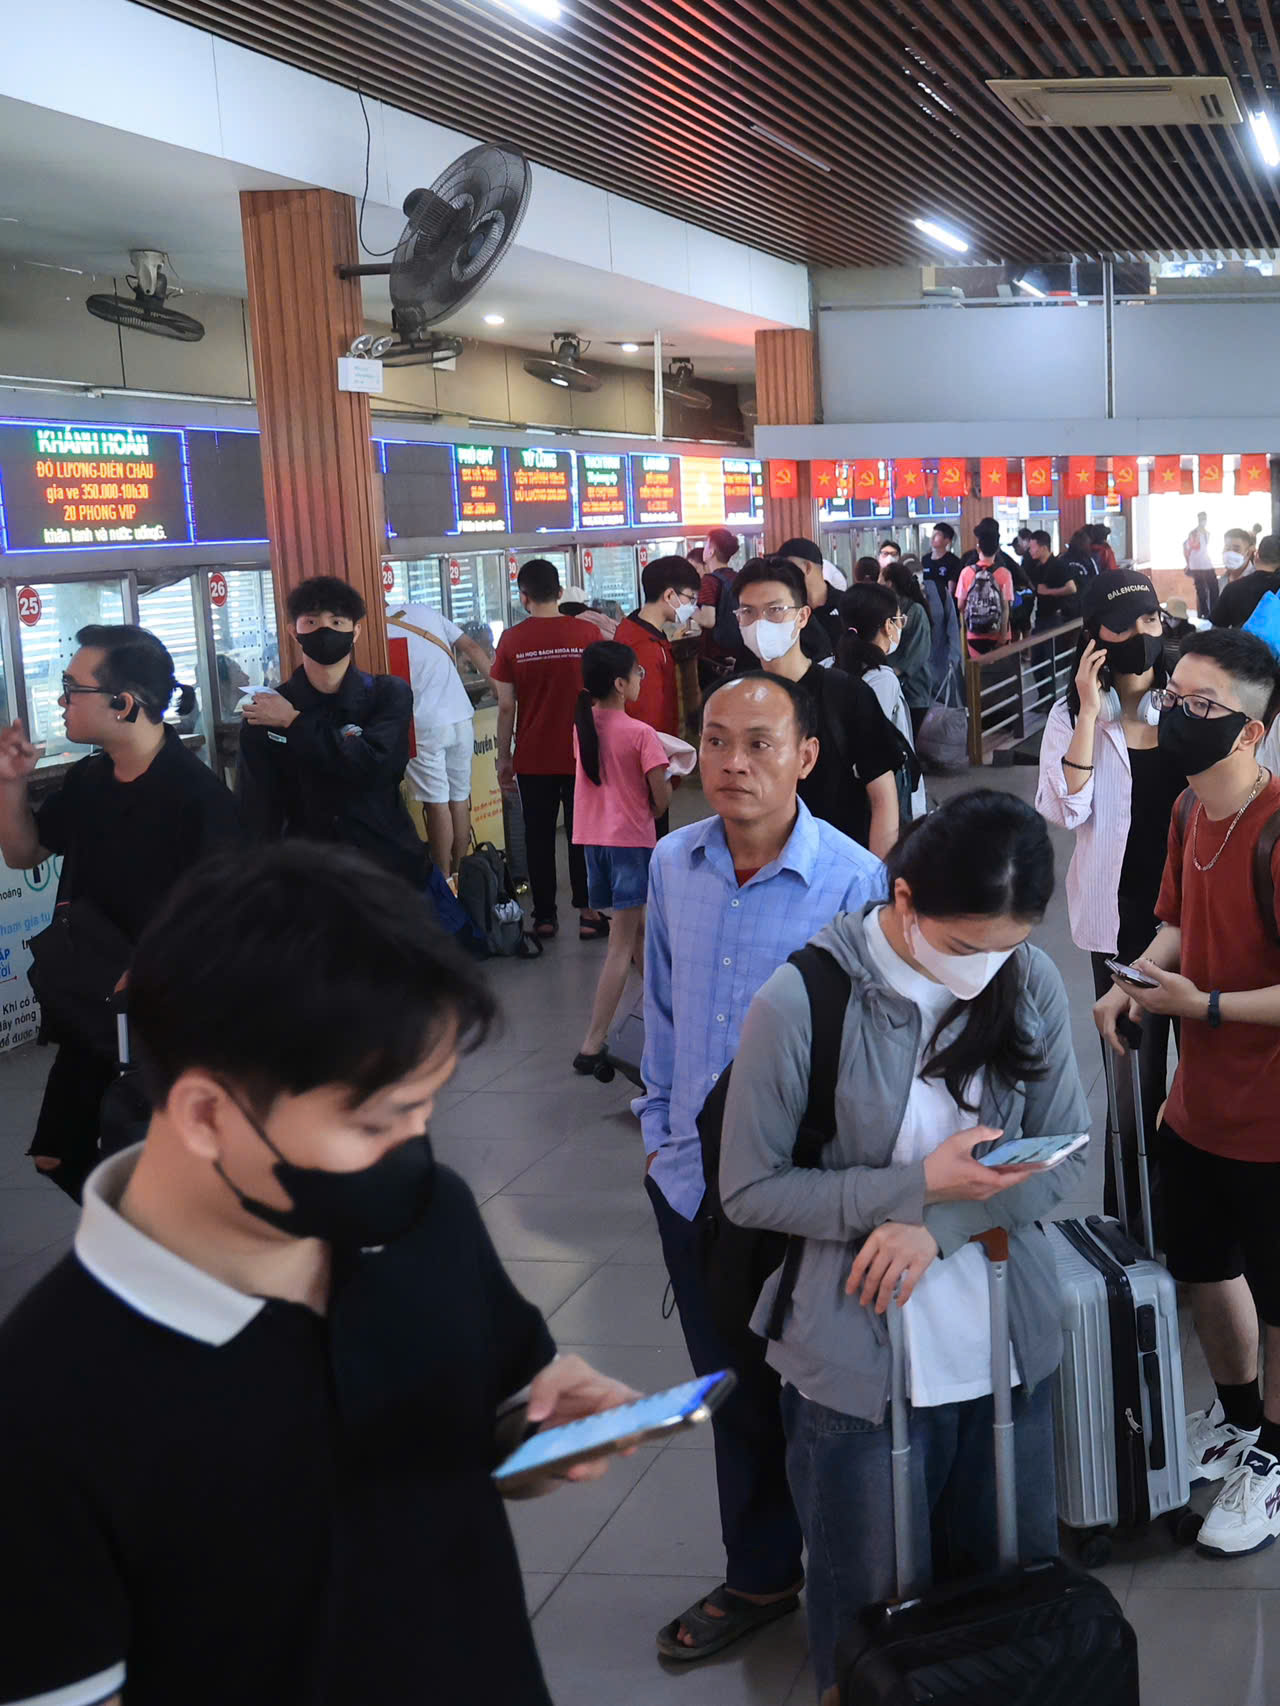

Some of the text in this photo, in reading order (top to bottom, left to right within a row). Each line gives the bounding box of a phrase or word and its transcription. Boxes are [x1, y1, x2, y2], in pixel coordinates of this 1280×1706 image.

[37, 426, 99, 454] KHÁNH
[63, 505, 76, 521] 20
[118, 504, 136, 520] VIP
[584, 556, 592, 568] 31
[382, 571, 393, 585] 28
[449, 566, 459, 579] 29
[210, 581, 225, 597] 26
[1107, 584, 1150, 600] BALENCIAGA
[19, 597, 39, 616] 25
